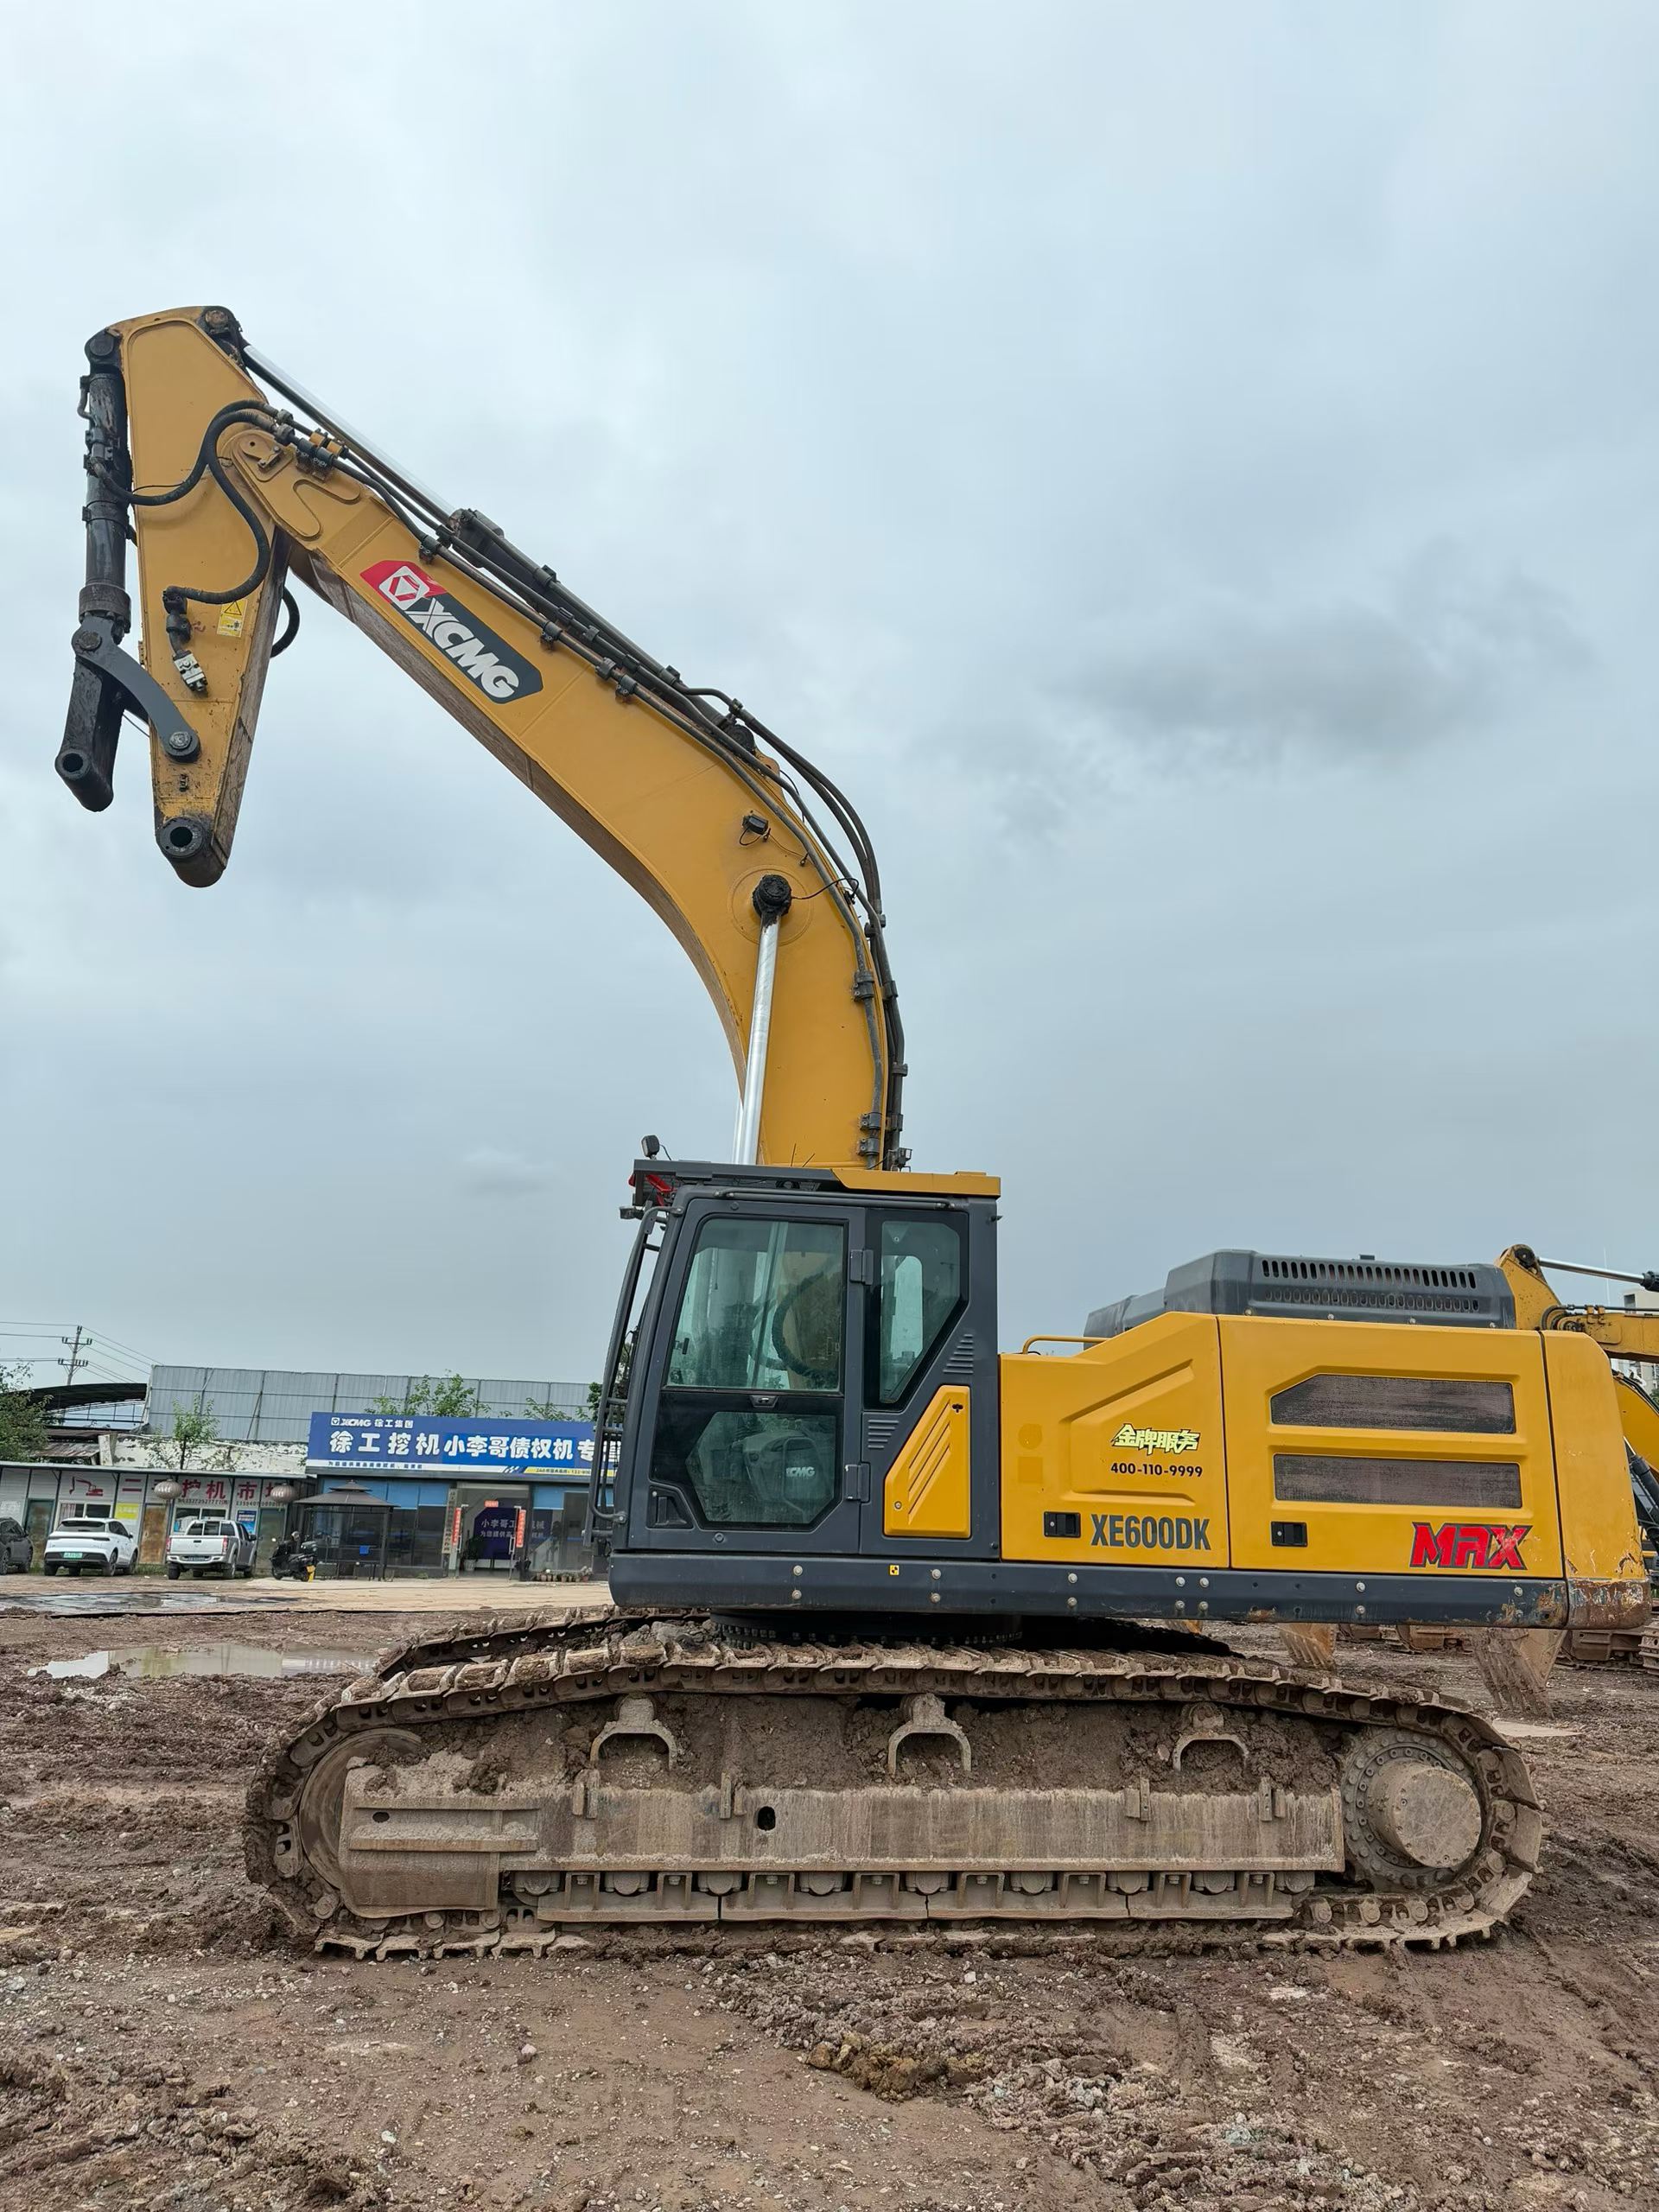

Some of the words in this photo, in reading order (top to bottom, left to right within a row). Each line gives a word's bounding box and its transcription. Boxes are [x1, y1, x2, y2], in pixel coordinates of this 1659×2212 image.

[404, 597, 519, 698] XCMG
[340, 1418, 372, 1427] XCMG
[1112, 1423, 1201, 1456] 金牌服务
[1110, 1462, 1203, 1478] 400-110-9999
[1090, 1514, 1211, 1550] XE600DK
[1409, 1522, 1534, 1570] MAX
